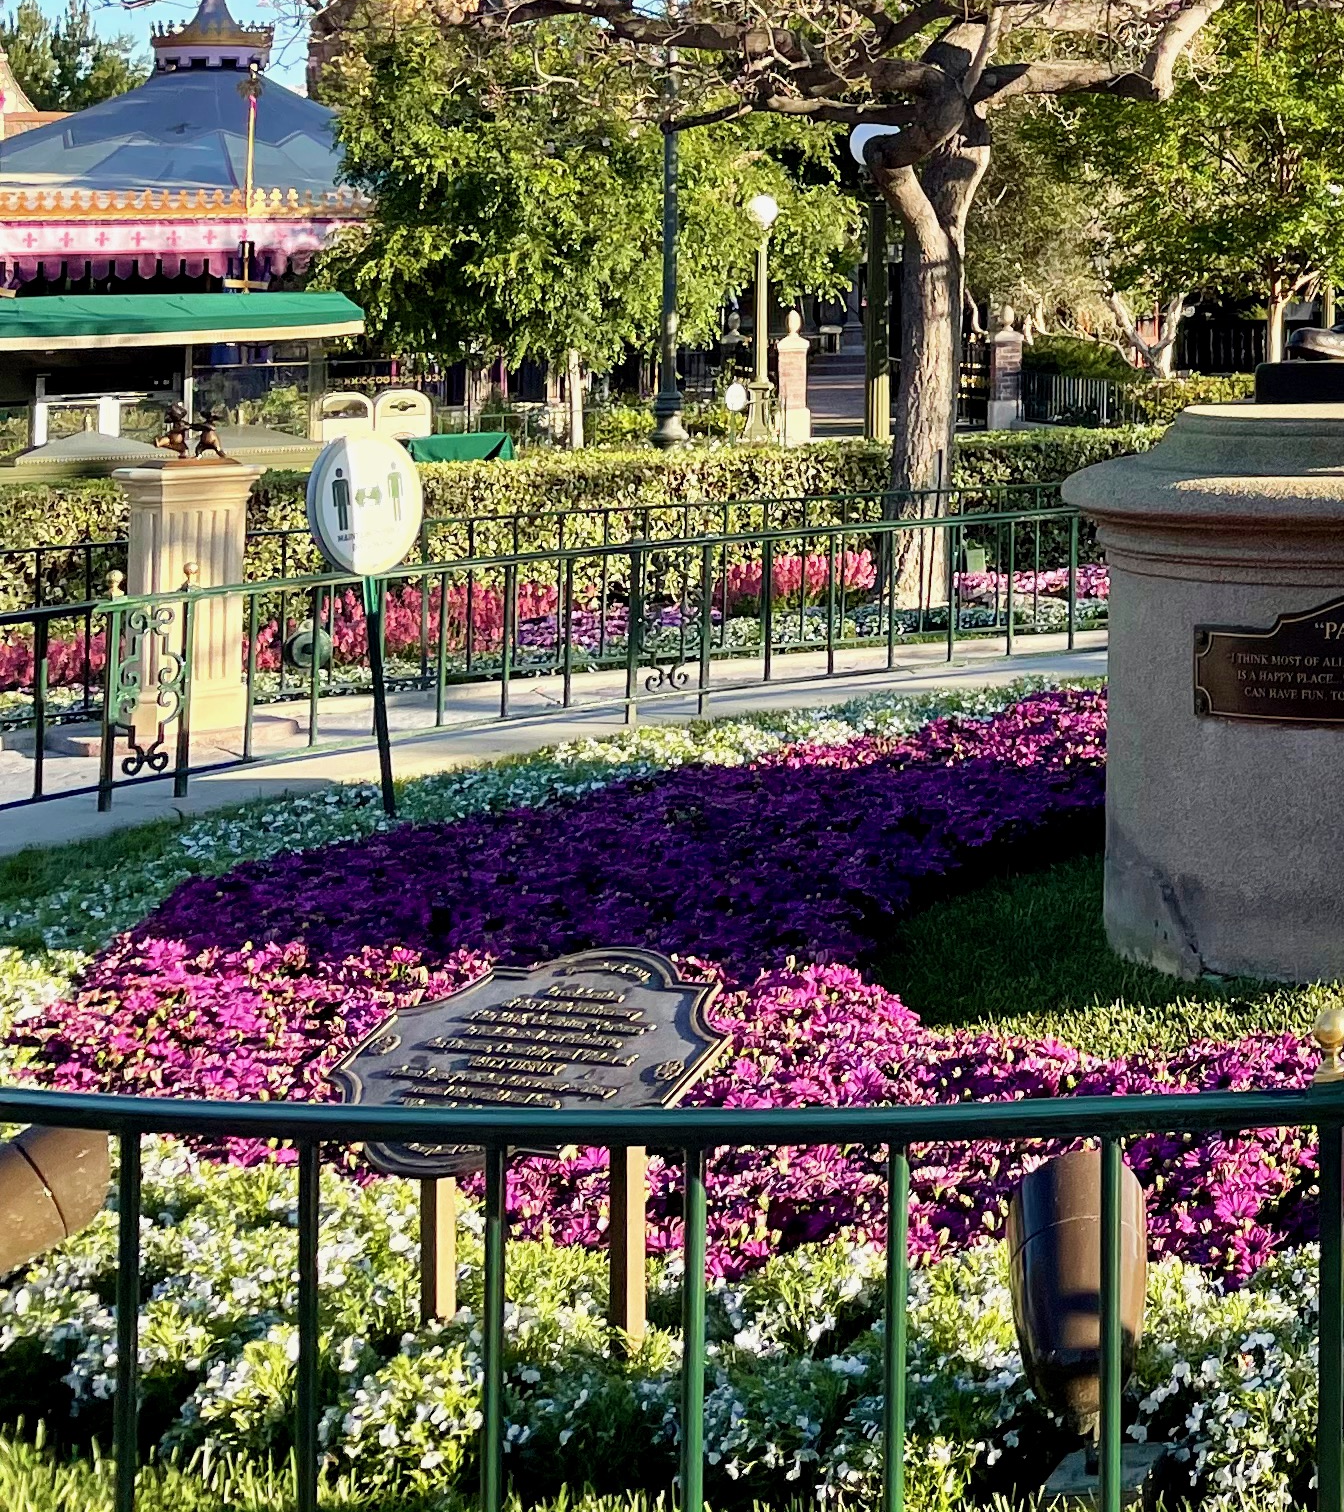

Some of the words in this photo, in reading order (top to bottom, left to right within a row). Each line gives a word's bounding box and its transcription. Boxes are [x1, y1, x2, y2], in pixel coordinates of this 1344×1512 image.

[1237, 653, 1269, 666] THINK
[1271, 655, 1302, 667] MOST
[1304, 657, 1320, 667] OF
[1237, 669, 1247, 681] IS
[1249, 670, 1257, 681] A
[1259, 671, 1294, 683] HAPPY
[1244, 687, 1266, 698] CAN
[1269, 688, 1298, 700] HAVE
